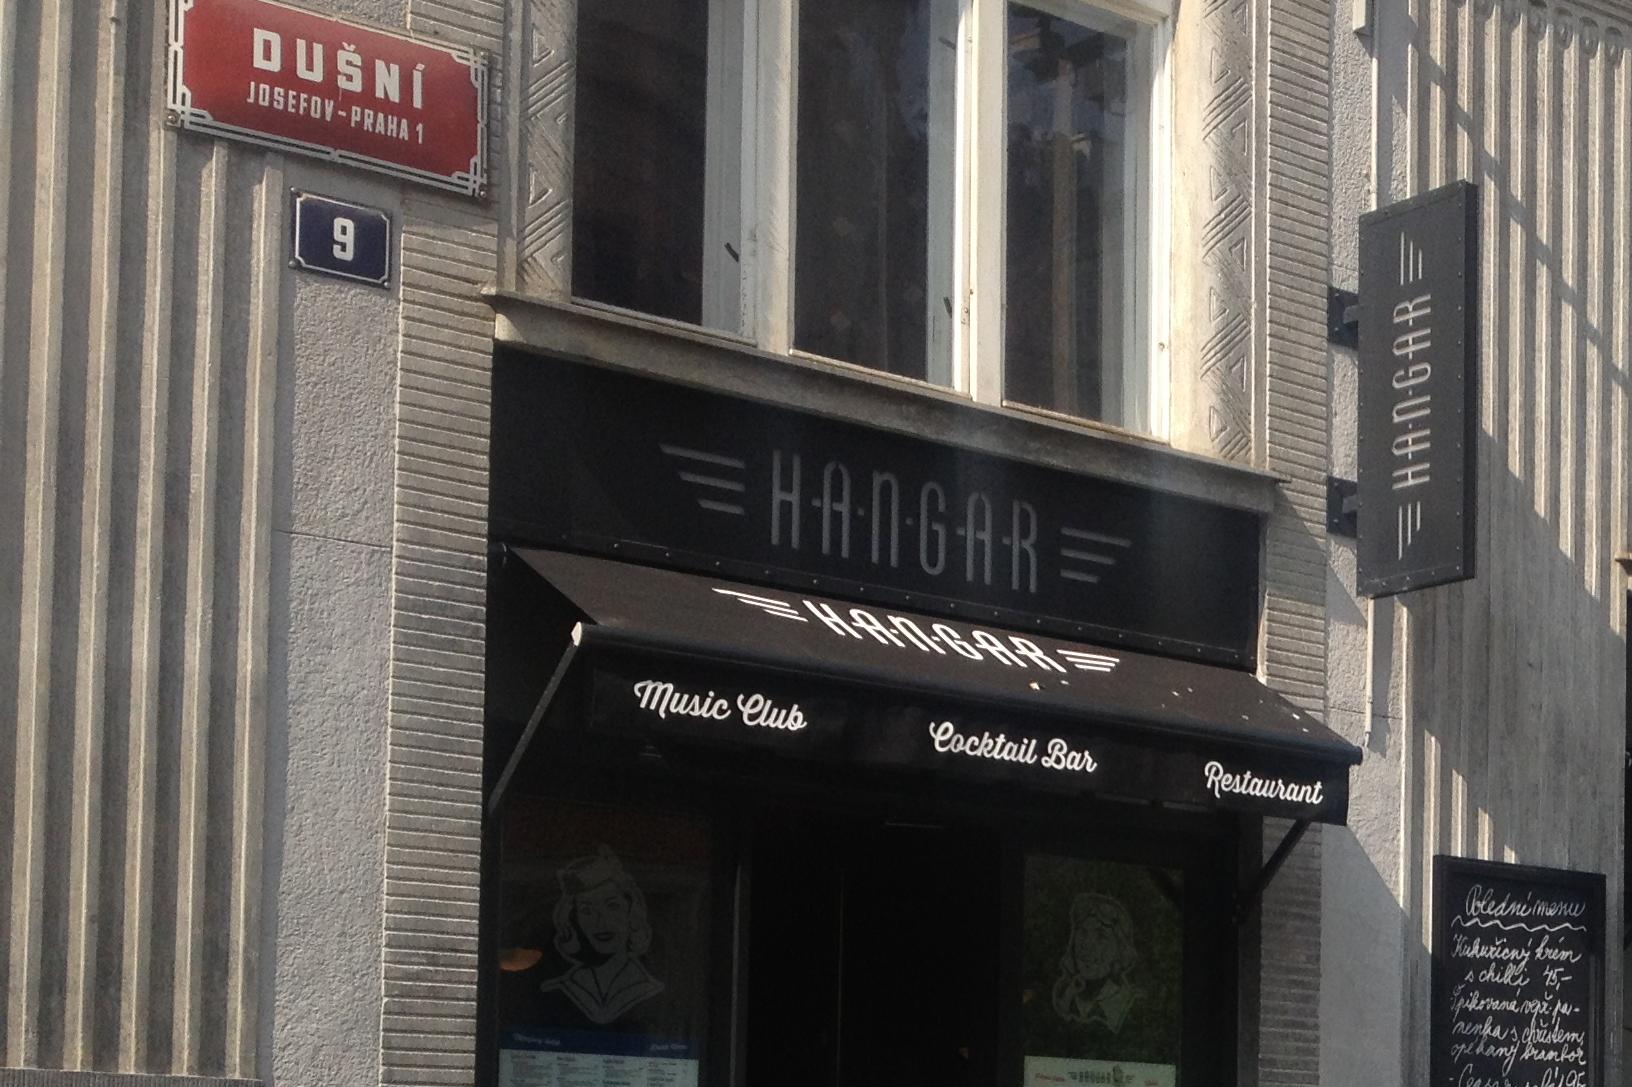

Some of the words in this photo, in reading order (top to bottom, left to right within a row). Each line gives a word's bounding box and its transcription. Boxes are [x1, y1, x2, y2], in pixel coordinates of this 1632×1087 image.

[252, 28, 425, 109] DUŠNÍ
[415, 124, 424, 144] 1
[332, 217, 355, 262] 9
[771, 449, 1038, 593] HANGAR
[803, 600, 1067, 673] HANGAR
[633, 680, 731, 720] Music
[737, 693, 808, 731] Club
[929, 720, 1038, 766] Cocktail
[1041, 737, 1098, 773] Bar
[1204, 761, 1324, 805] Restaurant
[1532, 899, 1586, 917] menu
[1465, 970, 1474, 983] s
